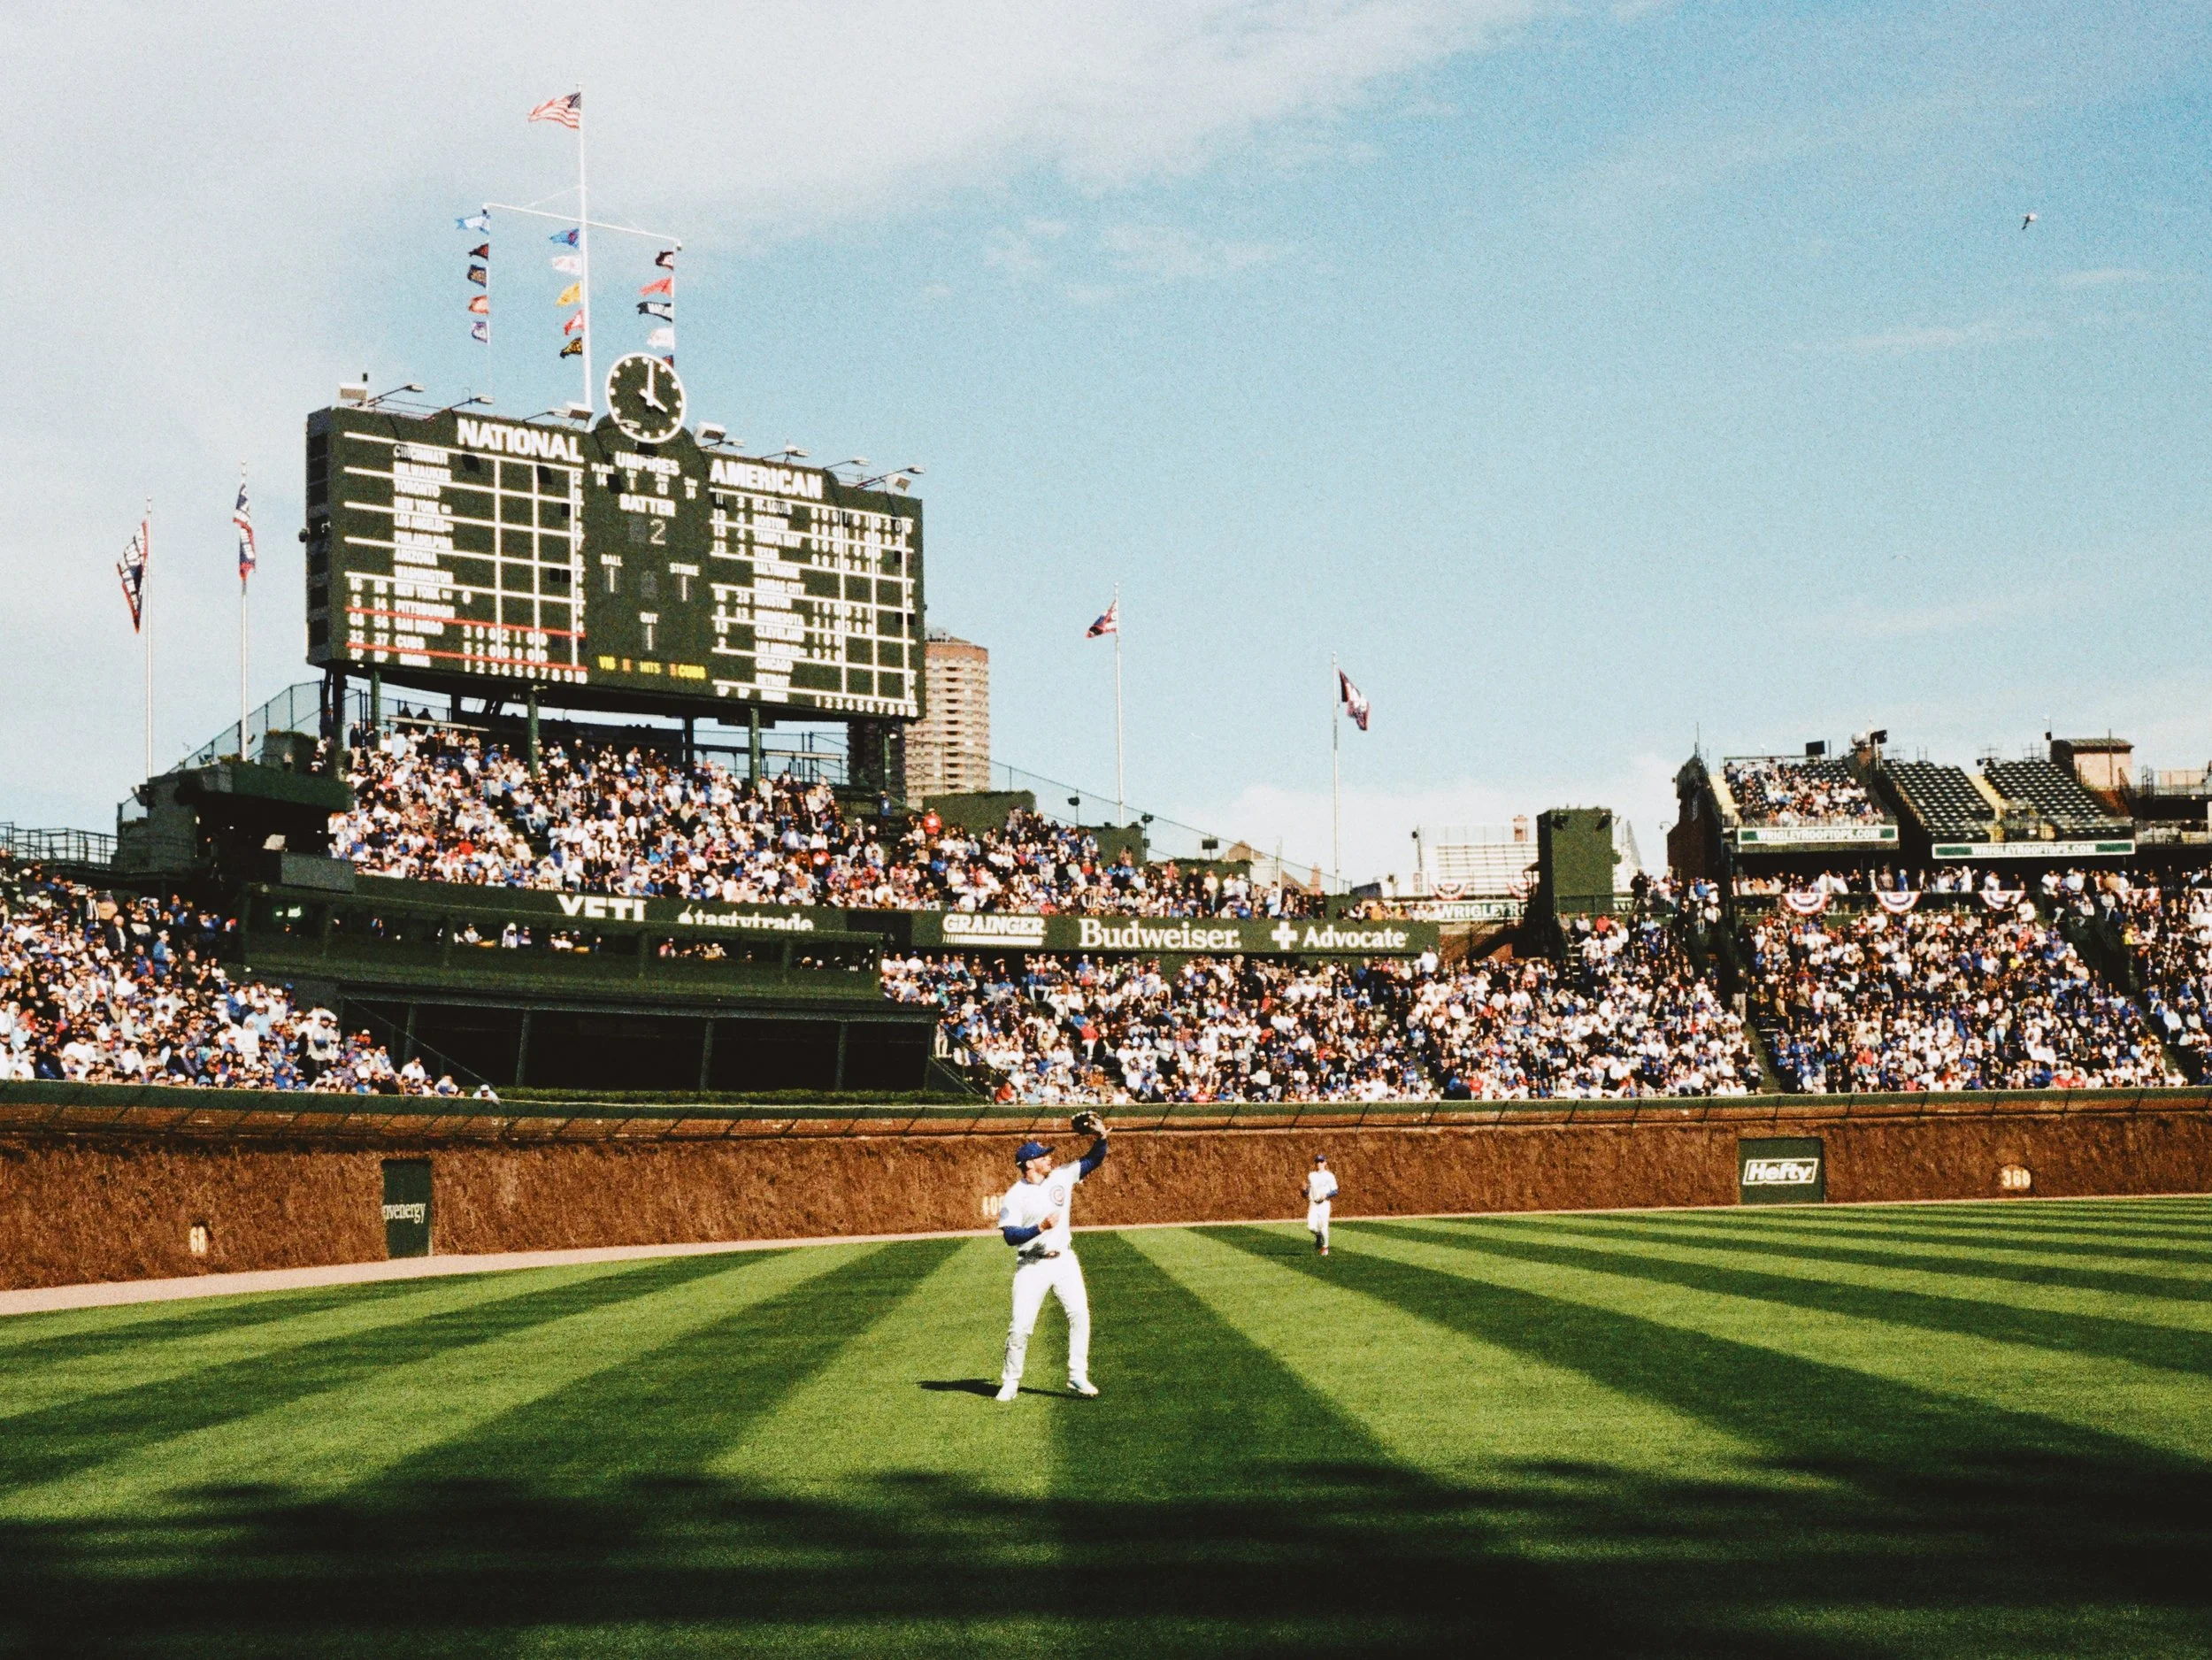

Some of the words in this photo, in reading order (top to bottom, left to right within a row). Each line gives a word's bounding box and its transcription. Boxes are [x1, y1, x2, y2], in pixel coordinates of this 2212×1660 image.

[457, 419, 584, 463] NATIONAL
[394, 445, 449, 465] CINCINNATI
[615, 450, 680, 476] UMPIRES
[394, 461, 451, 482] MILWAUKEE
[710, 459, 822, 500] AMERICAN
[395, 479, 441, 497] TORONTO
[394, 496, 413, 512] NEW
[414, 499, 440, 514] YORK
[620, 493, 676, 517] BATTER
[753, 496, 766, 511] ST.
[767, 499, 793, 515] LOUIS
[394, 513, 411, 528] LOS
[753, 514, 788, 532] BOSTON
[395, 530, 453, 549] PHILADELPHIA
[650, 519, 665, 545] 2
[754, 529, 783, 545] TAMPA
[395, 548, 438, 565] ARIZONA
[601, 554, 623, 566] BALL
[754, 545, 779, 561] TEXAS
[395, 565, 453, 585] WASHINGTON
[670, 563, 699, 577] STRIKE
[754, 560, 801, 580] BALTIMORE
[395, 581, 414, 597] NEW
[415, 585, 441, 600] YORK
[754, 578, 786, 594] KANSAS
[787, 582, 805, 597] CITY
[353, 594, 362, 608] 5
[395, 599, 455, 619] PITTSBURGH
[755, 592, 792, 609] HOUSTON
[640, 611, 658, 624] OUT
[755, 609, 804, 629] MINNESOTA
[395, 616, 414, 631] SAN
[414, 619, 444, 634] DIEGO
[465, 625, 472, 638] 3
[476, 626, 485, 640] 0
[755, 622, 804, 642] CLEVELAND
[396, 634, 426, 649] CUBS
[464, 642, 472, 656] 5
[476, 643, 485, 657] 2
[465, 659, 471, 672] 1
[476, 661, 486, 674] 2
[489, 662, 498, 676] 3
[501, 664, 511, 677] 4
[515, 665, 524, 678] 5
[527, 665, 536, 680] 6
[541, 667, 549, 680] 7
[552, 668, 561, 682] 8
[565, 670, 573, 683] 9
[576, 670, 588, 685] 10
[640, 662, 661, 674] HITS
[757, 655, 794, 672] CHICAGO
[757, 672, 790, 688] DETROIT
[816, 694, 821, 708] 1
[825, 696, 833, 709] 2
[835, 697, 844, 711] 3
[846, 698, 855, 711] 4
[856, 699, 866, 712] 5
[866, 700, 875, 713] 6
[877, 701, 885, 714] 7
[887, 703, 895, 716] 8
[897, 704, 906, 717] 9
[1758, 828, 1879, 842] WRIGLEYROOFTOPS.COM
[1971, 843, 2095, 857] WRIGLEYROOFTOPS.COM
[557, 895, 647, 922] YETI
[695, 909, 814, 932] tastytrade
[943, 914, 1047, 935] GRAINGER
[1303, 924, 1409, 949] Advocate
[1747, 1162, 1813, 1184] Hefty
